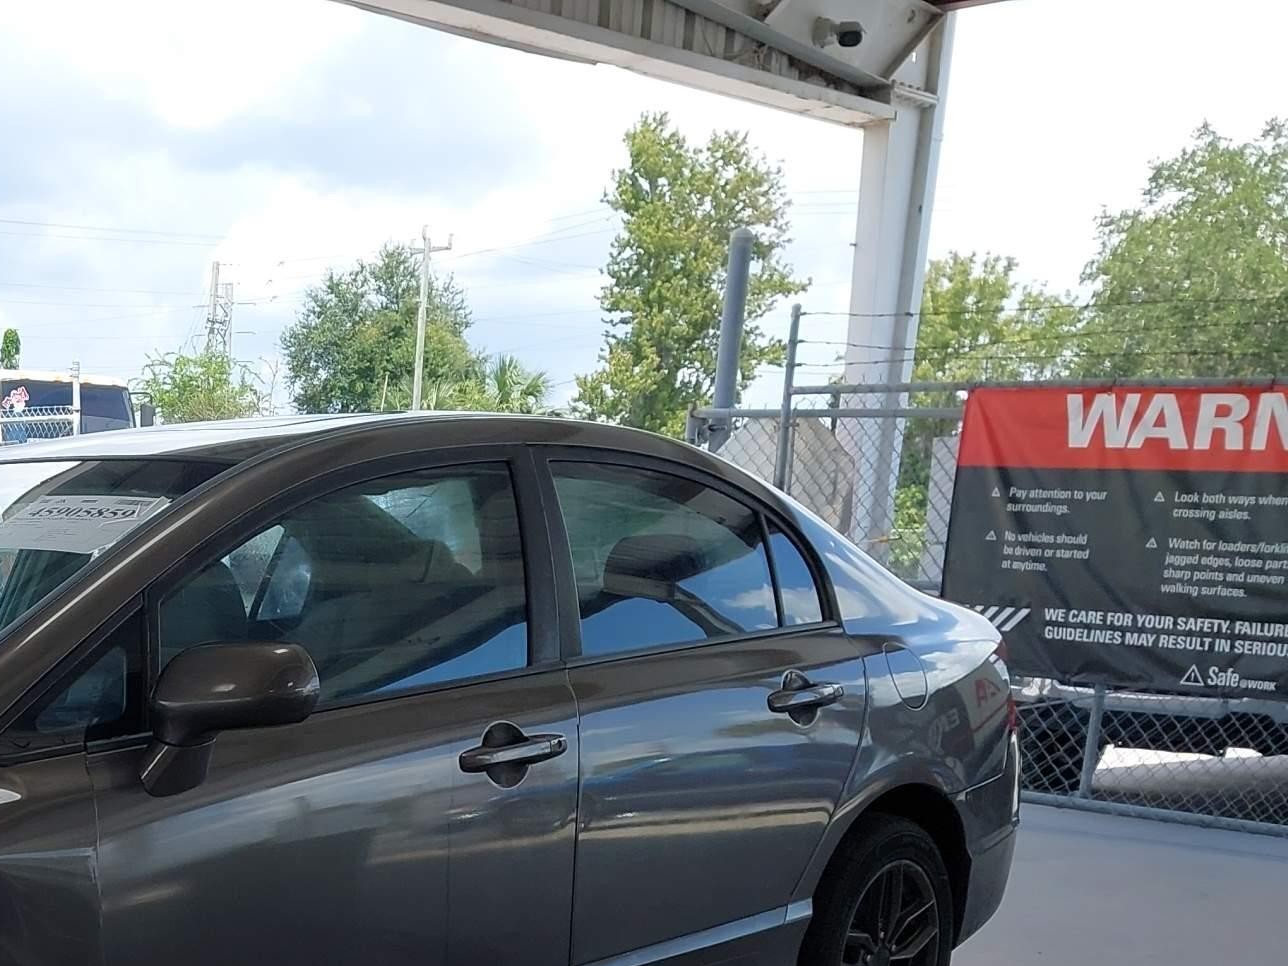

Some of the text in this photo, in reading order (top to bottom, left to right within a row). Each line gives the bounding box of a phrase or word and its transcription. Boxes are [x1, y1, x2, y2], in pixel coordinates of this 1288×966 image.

[1066, 393, 1288, 450] WARN
[1009, 487, 1108, 501] Pay attention to your
[1175, 491, 1199, 503] Look
[1202, 492, 1226, 504] both
[1228, 495, 1256, 506] ways
[29, 506, 136, 519] 45905859
[1006, 502, 1070, 515] surroundings.
[1173, 507, 1251, 521] crossing aisles.
[1004, 530, 1088, 545] No vehicles should
[1168, 537, 1200, 550] Watch
[1203, 539, 1216, 550] for
[1003, 545, 1090, 559] be driven or started
[1001, 560, 1048, 572] at anytime.
[1165, 552, 1199, 566] jagged
[1201, 555, 1232, 568] edges,
[1235, 556, 1263, 568] loose
[1163, 568, 1285, 584] sharp points and uneven
[1161, 583, 1247, 598] walking surfaces.
[1044, 608, 1288, 638] WE CARE FOR YOUR SAFETY. FAILURE
[1044, 626, 1288, 657] GUIDELINES MAY RESULT IN SERIOU
